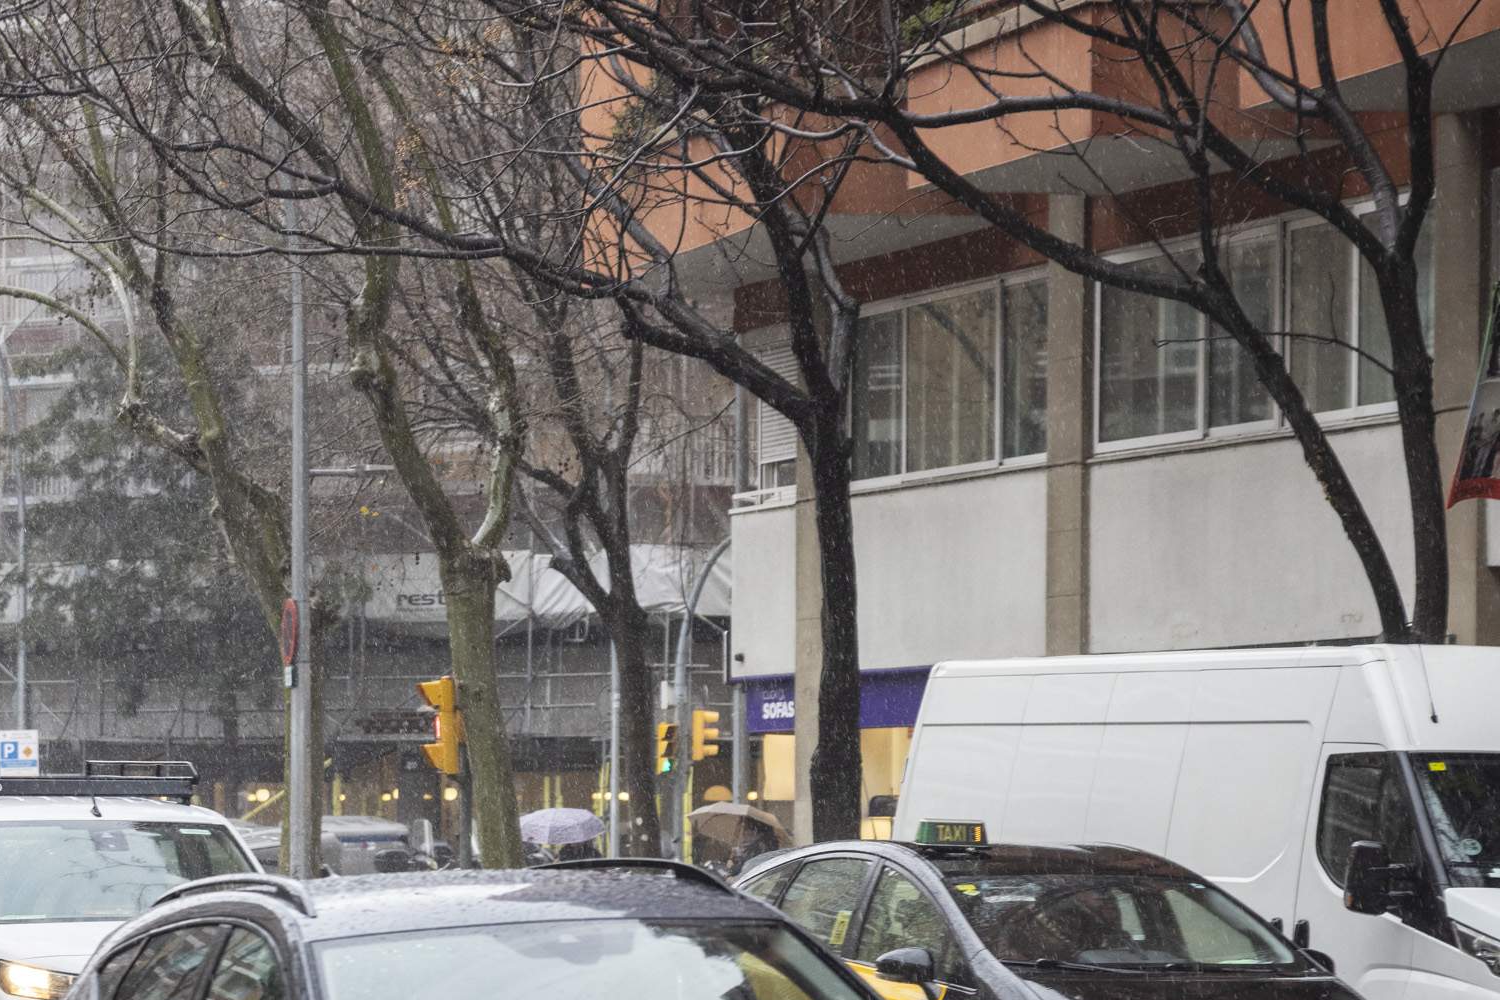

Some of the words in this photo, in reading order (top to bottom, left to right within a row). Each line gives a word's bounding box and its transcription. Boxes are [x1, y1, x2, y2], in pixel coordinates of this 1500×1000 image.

[762, 701, 796, 720] SOFAS
[3, 743, 15, 759] P
[935, 824, 967, 842] TAXI
